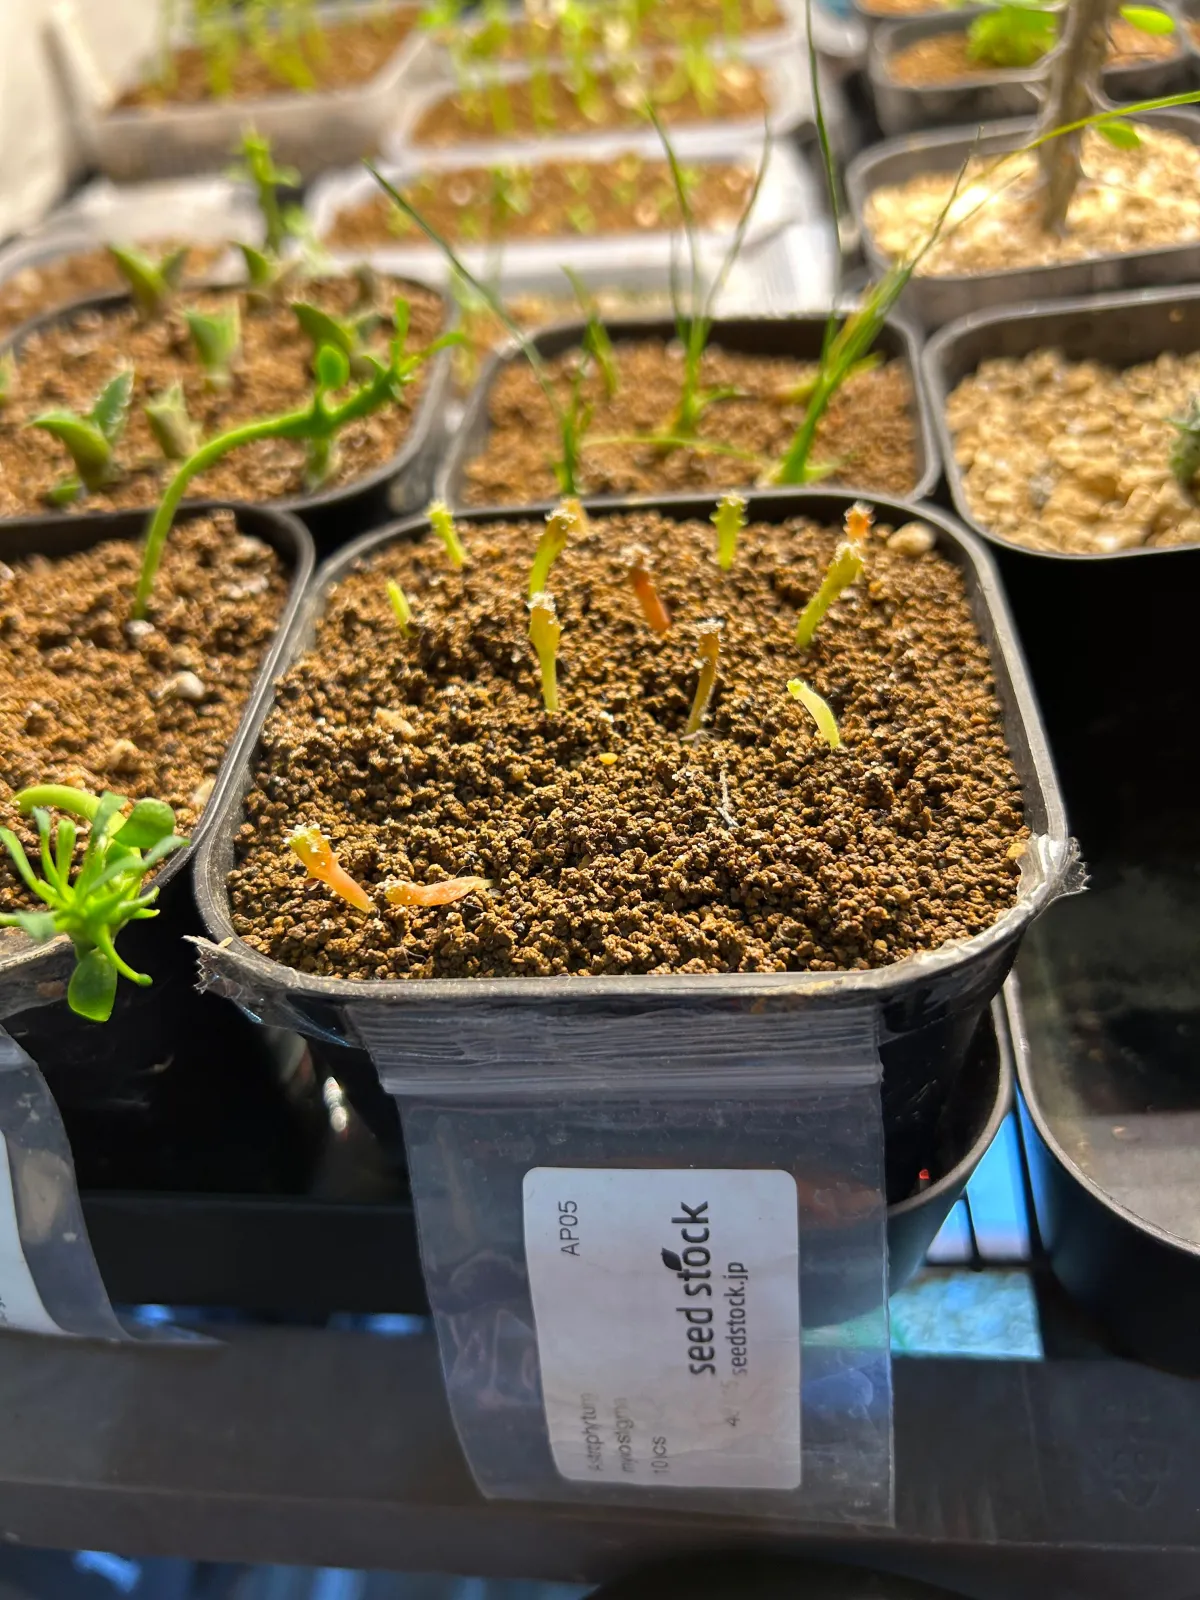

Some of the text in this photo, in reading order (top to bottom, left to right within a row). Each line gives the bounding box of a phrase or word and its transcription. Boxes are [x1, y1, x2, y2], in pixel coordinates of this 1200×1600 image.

[558, 1200, 580, 1256] AP05
[671, 1201, 716, 1375] seed stock
[722, 1261, 748, 1377] seedstock.jp
